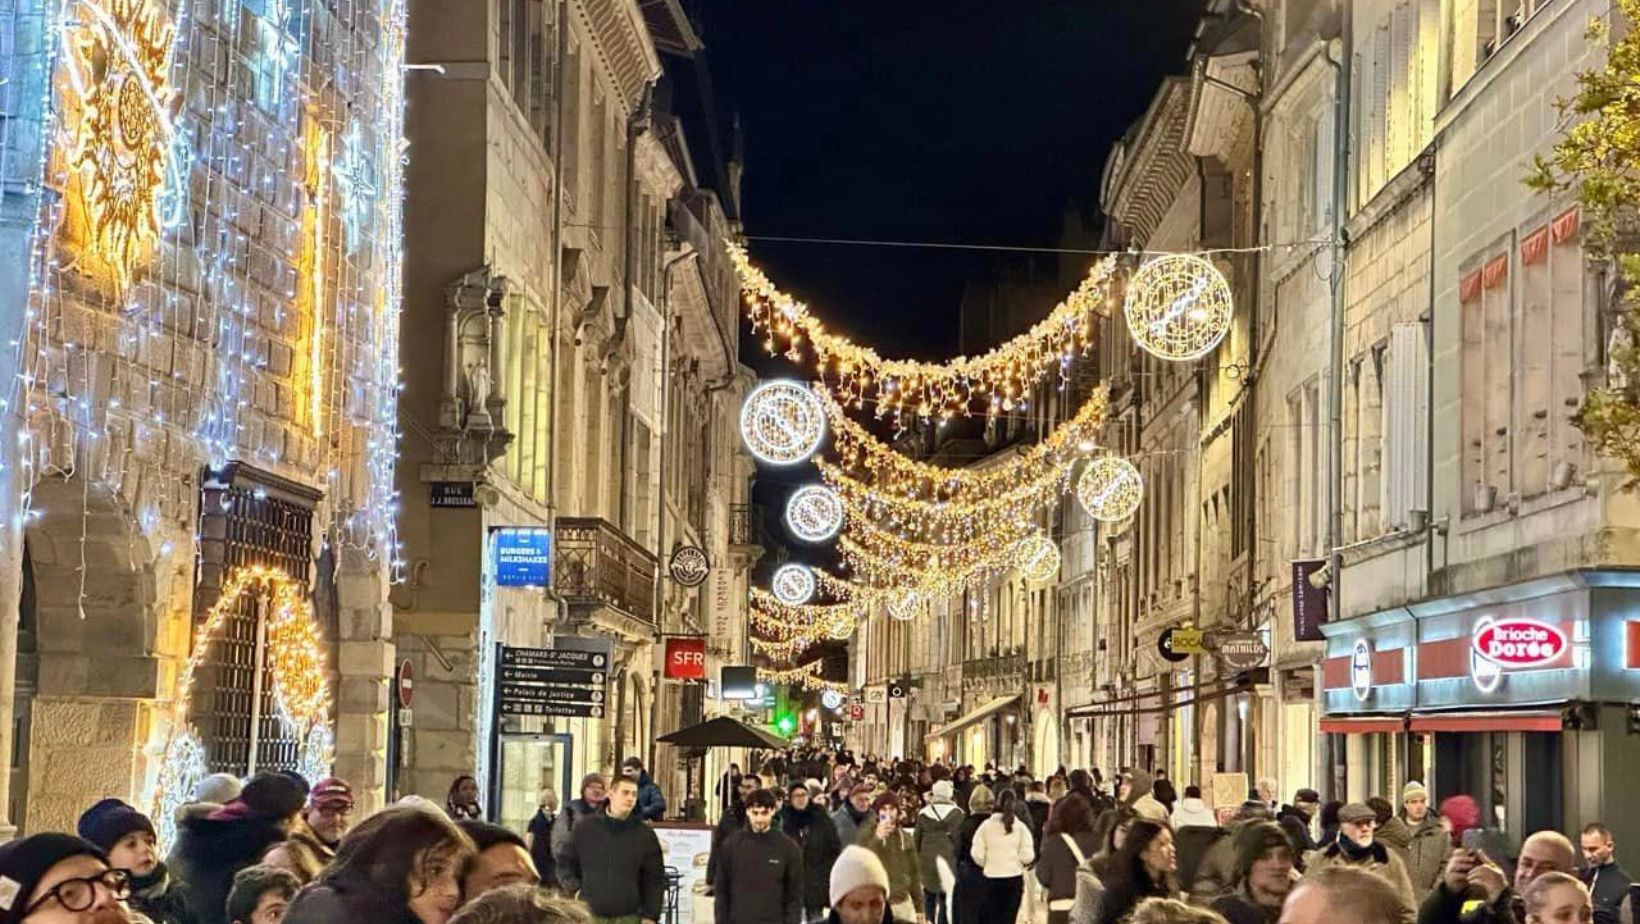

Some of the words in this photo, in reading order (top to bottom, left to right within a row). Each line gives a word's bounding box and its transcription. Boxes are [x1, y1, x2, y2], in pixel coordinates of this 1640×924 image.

[500, 547, 535, 555] BURGERS
[500, 556, 548, 564] MILKSHAKES
[1493, 627, 1548, 641] Brioche
[1221, 644, 1263, 654] MATHILDE
[1488, 640, 1555, 658] Dorée
[558, 652, 588, 661] JACQUES
[674, 651, 703, 665] SFR
[514, 671, 538, 679] Mairie
[513, 688, 535, 696] Palais
[537, 689, 547, 697] de
[545, 705, 576, 714] Toilettes
